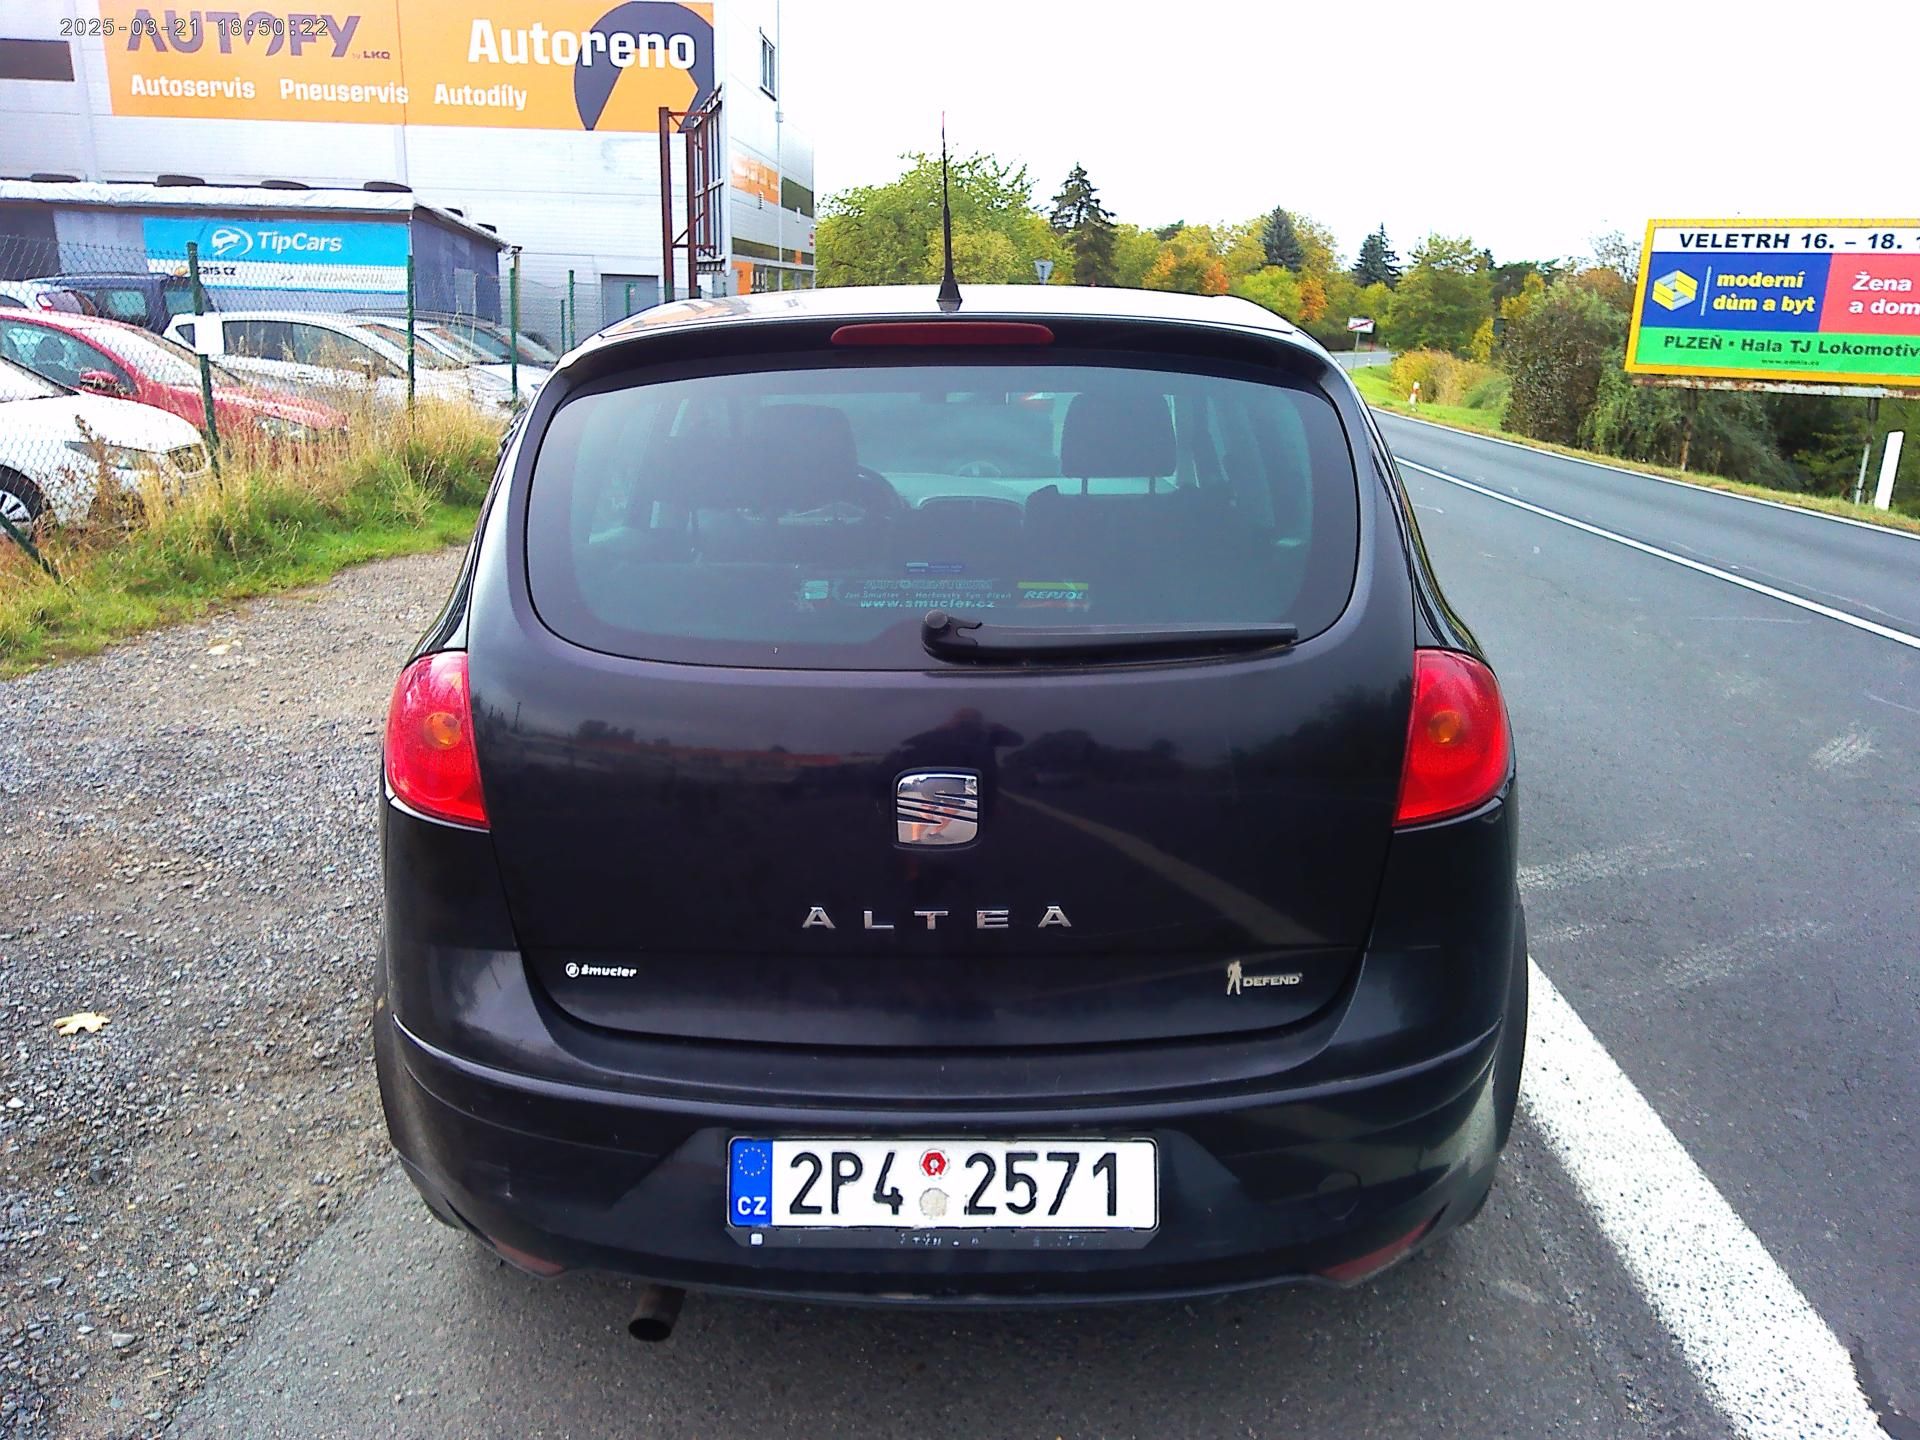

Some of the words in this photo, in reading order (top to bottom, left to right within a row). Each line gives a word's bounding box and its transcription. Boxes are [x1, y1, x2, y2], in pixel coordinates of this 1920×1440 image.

[127, 9, 361, 57] AUTOFY
[363, 50, 391, 60] LKQ
[467, 18, 697, 70] Autoreno
[131, 74, 256, 99] Autoservis
[280, 78, 409, 104] Pneuservis
[434, 83, 528, 111] Autodíly
[257, 231, 343, 254] TipCars
[1680, 233, 1790, 249] VELETRH
[1801, 233, 1835, 249] 16.
[1867, 233, 1903, 249] 18.
[1716, 271, 1806, 288] moderní
[1852, 271, 1912, 292] Žena
[1713, 293, 1758, 311] dům
[1762, 298, 1777, 311] a
[1781, 295, 1816, 315] byt
[1848, 301, 1864, 314] a
[1663, 335, 1723, 350] PLZEŇ
[1741, 338, 1783, 353] Hala
[1790, 340, 1811, 353] TJ
[802, 906, 1072, 930] ALTEA
[1243, 975, 1300, 987] DEFEND
[789, 1152, 903, 1215] 2P4
[964, 1152, 1118, 1216] 2571
[737, 1196, 767, 1215] CZ
